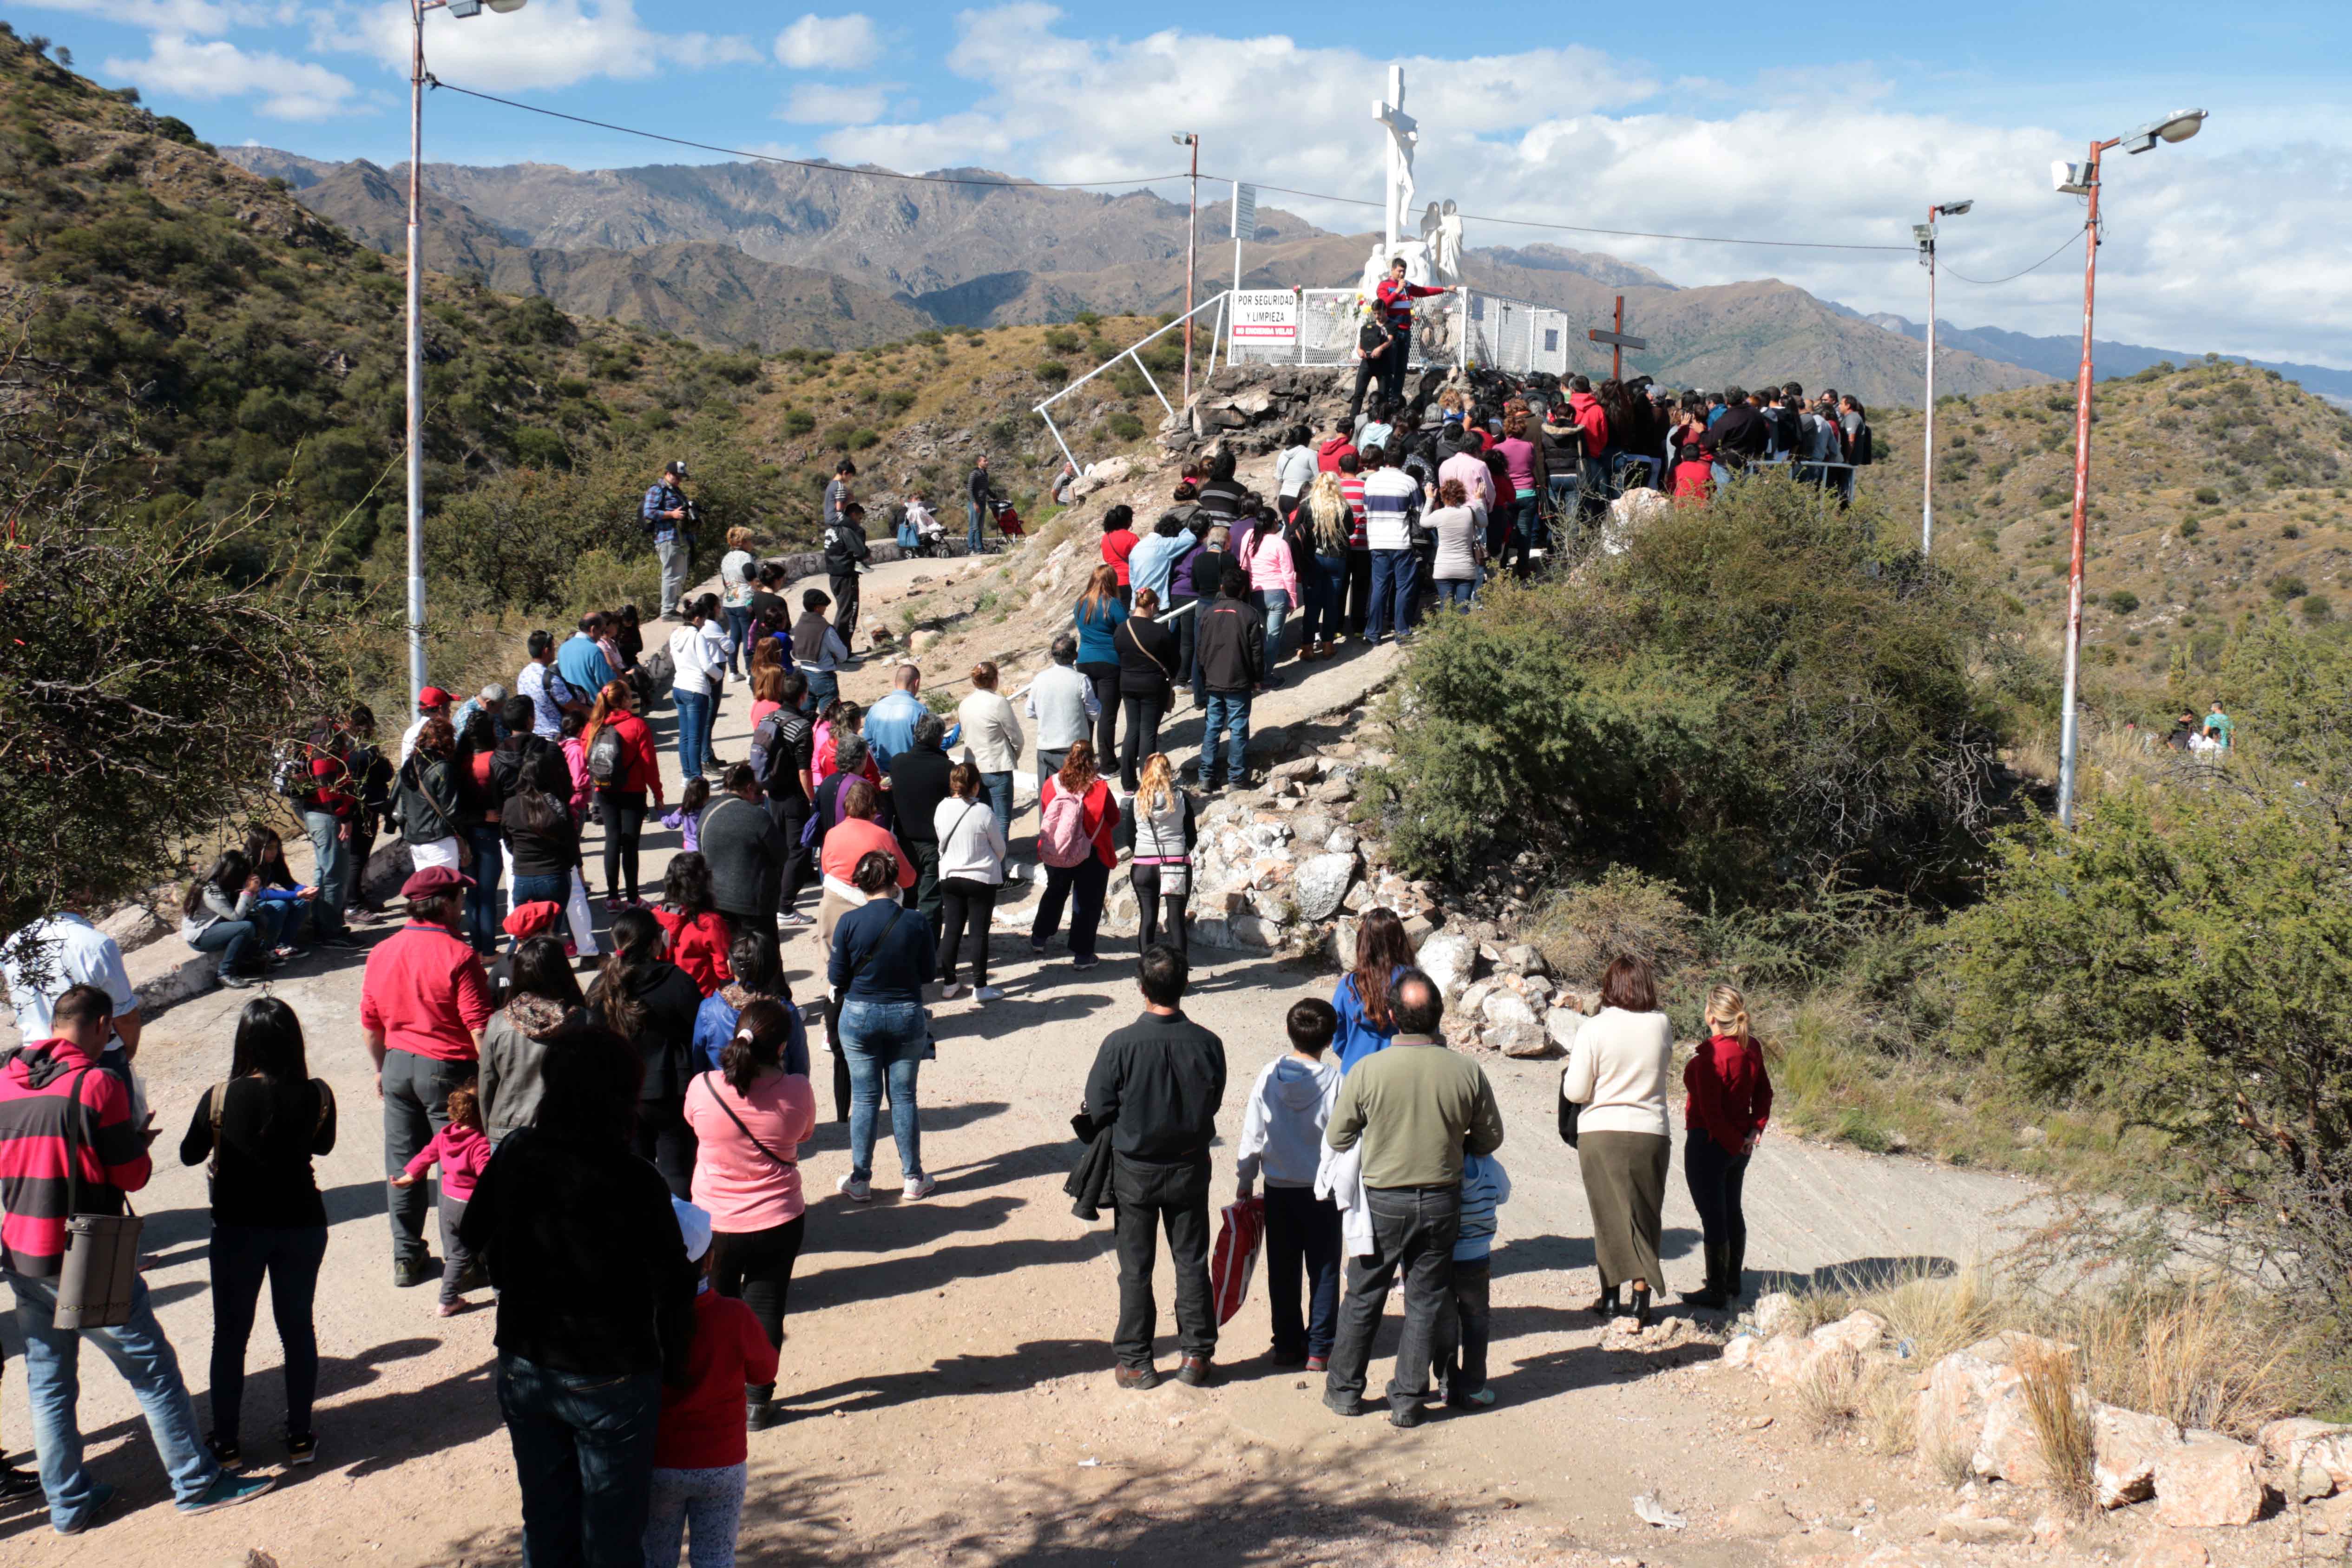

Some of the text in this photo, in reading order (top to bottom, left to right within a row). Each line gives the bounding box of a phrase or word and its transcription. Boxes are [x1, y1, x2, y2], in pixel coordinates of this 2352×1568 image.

[1238, 295, 1294, 305] POR SEGURIDAD
[1247, 312, 1284, 322] Y LIMPIEZA
